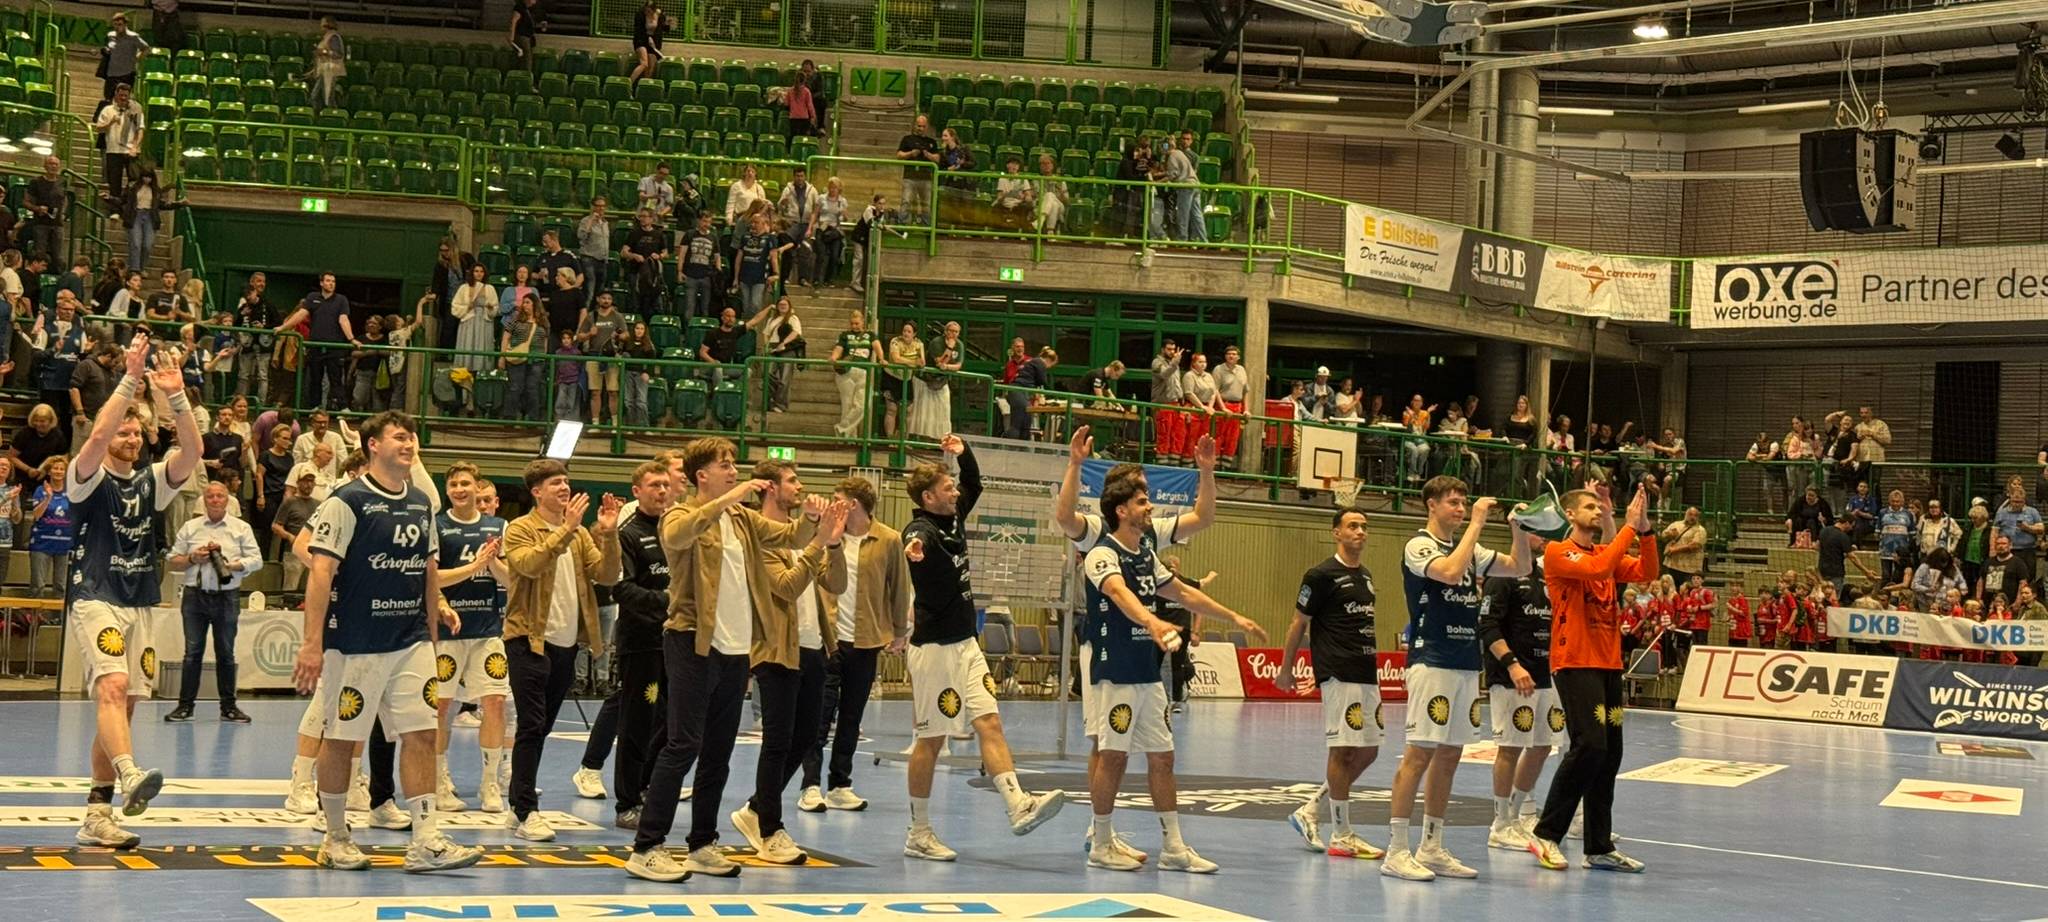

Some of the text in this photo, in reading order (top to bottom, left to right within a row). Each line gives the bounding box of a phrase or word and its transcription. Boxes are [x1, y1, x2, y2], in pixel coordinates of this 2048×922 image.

[857, 70, 902, 93] Y Z
[1382, 220, 1439, 249] Billstein
[1360, 246, 1438, 274] Der Frische wegen!
[1481, 243, 1527, 278] BBB
[1606, 269, 1657, 280] catering
[1717, 262, 1838, 302] oxe
[1861, 274, 1986, 303] Partner
[1714, 301, 1838, 322] werbung.de
[1156, 488, 1189, 503] Bergisch
[393, 523, 420, 547] 49
[1136, 575, 1156, 597] 33
[372, 598, 416, 609] Bohnen
[450, 599, 485, 608] Bohnen
[1849, 613, 1900, 636] DKB
[1972, 624, 2026, 646] DKB
[1830, 697, 1882, 710] Schaum
[1929, 686, 2048, 711] WILKINS
[1811, 708, 1879, 723] nach Maß
[1972, 710, 2034, 724] SWORD
[375, 901, 1003, 920] DAIKIN
